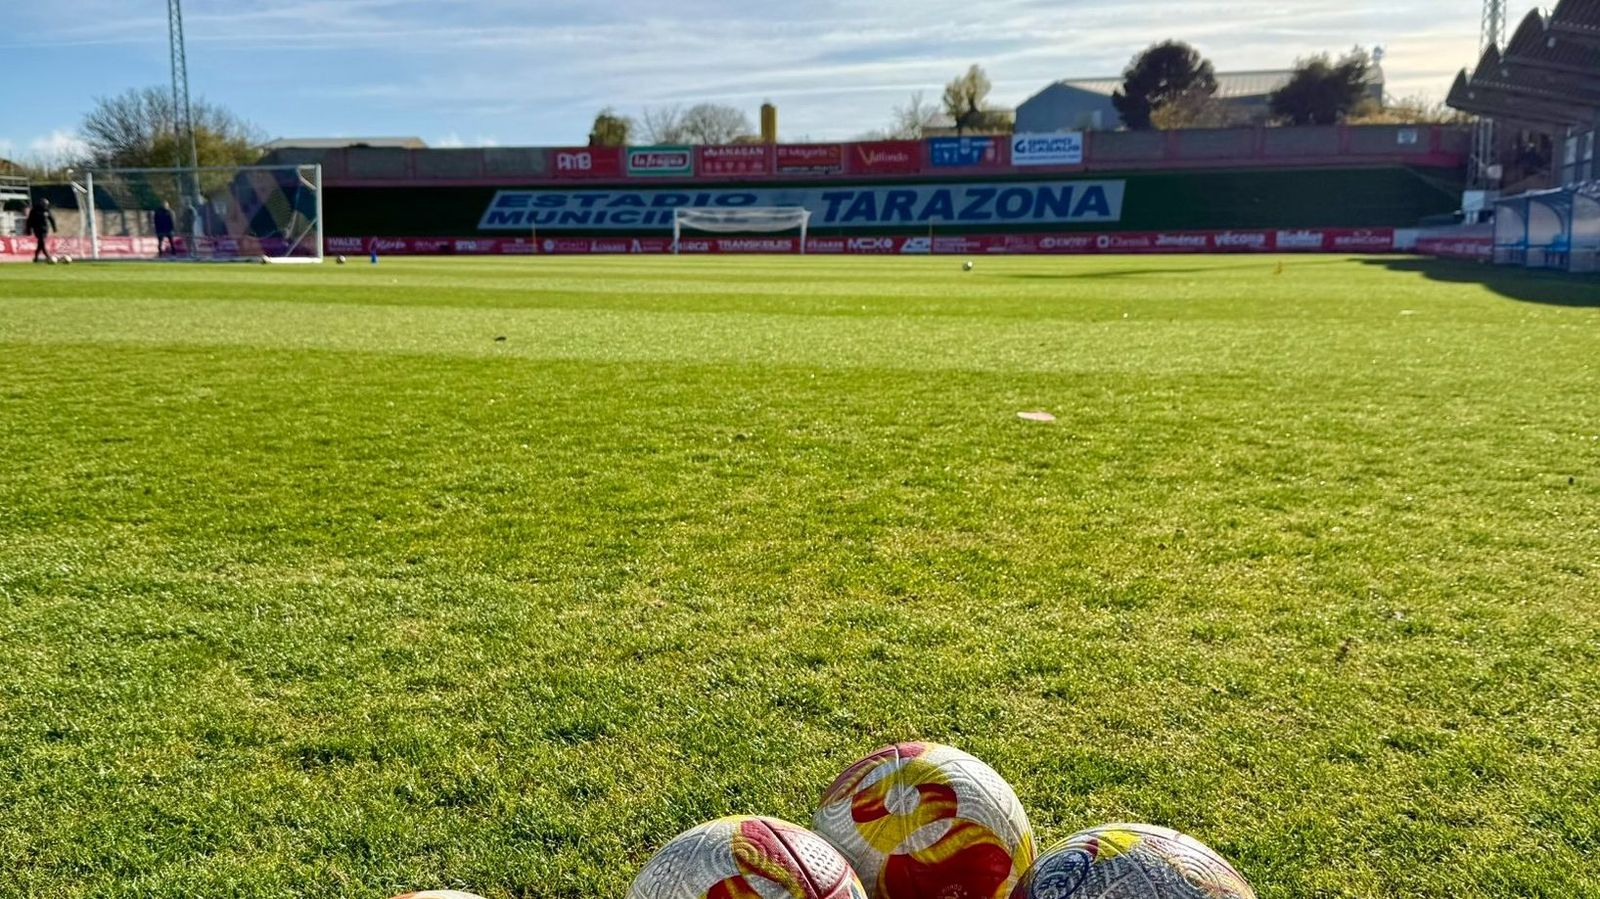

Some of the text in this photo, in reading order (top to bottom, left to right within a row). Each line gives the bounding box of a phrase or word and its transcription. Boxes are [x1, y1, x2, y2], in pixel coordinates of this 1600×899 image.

[501, 191, 759, 207] ESTADIO
[820, 185, 1111, 223] TARAZONA
[486, 210, 749, 226] MUNICIP
